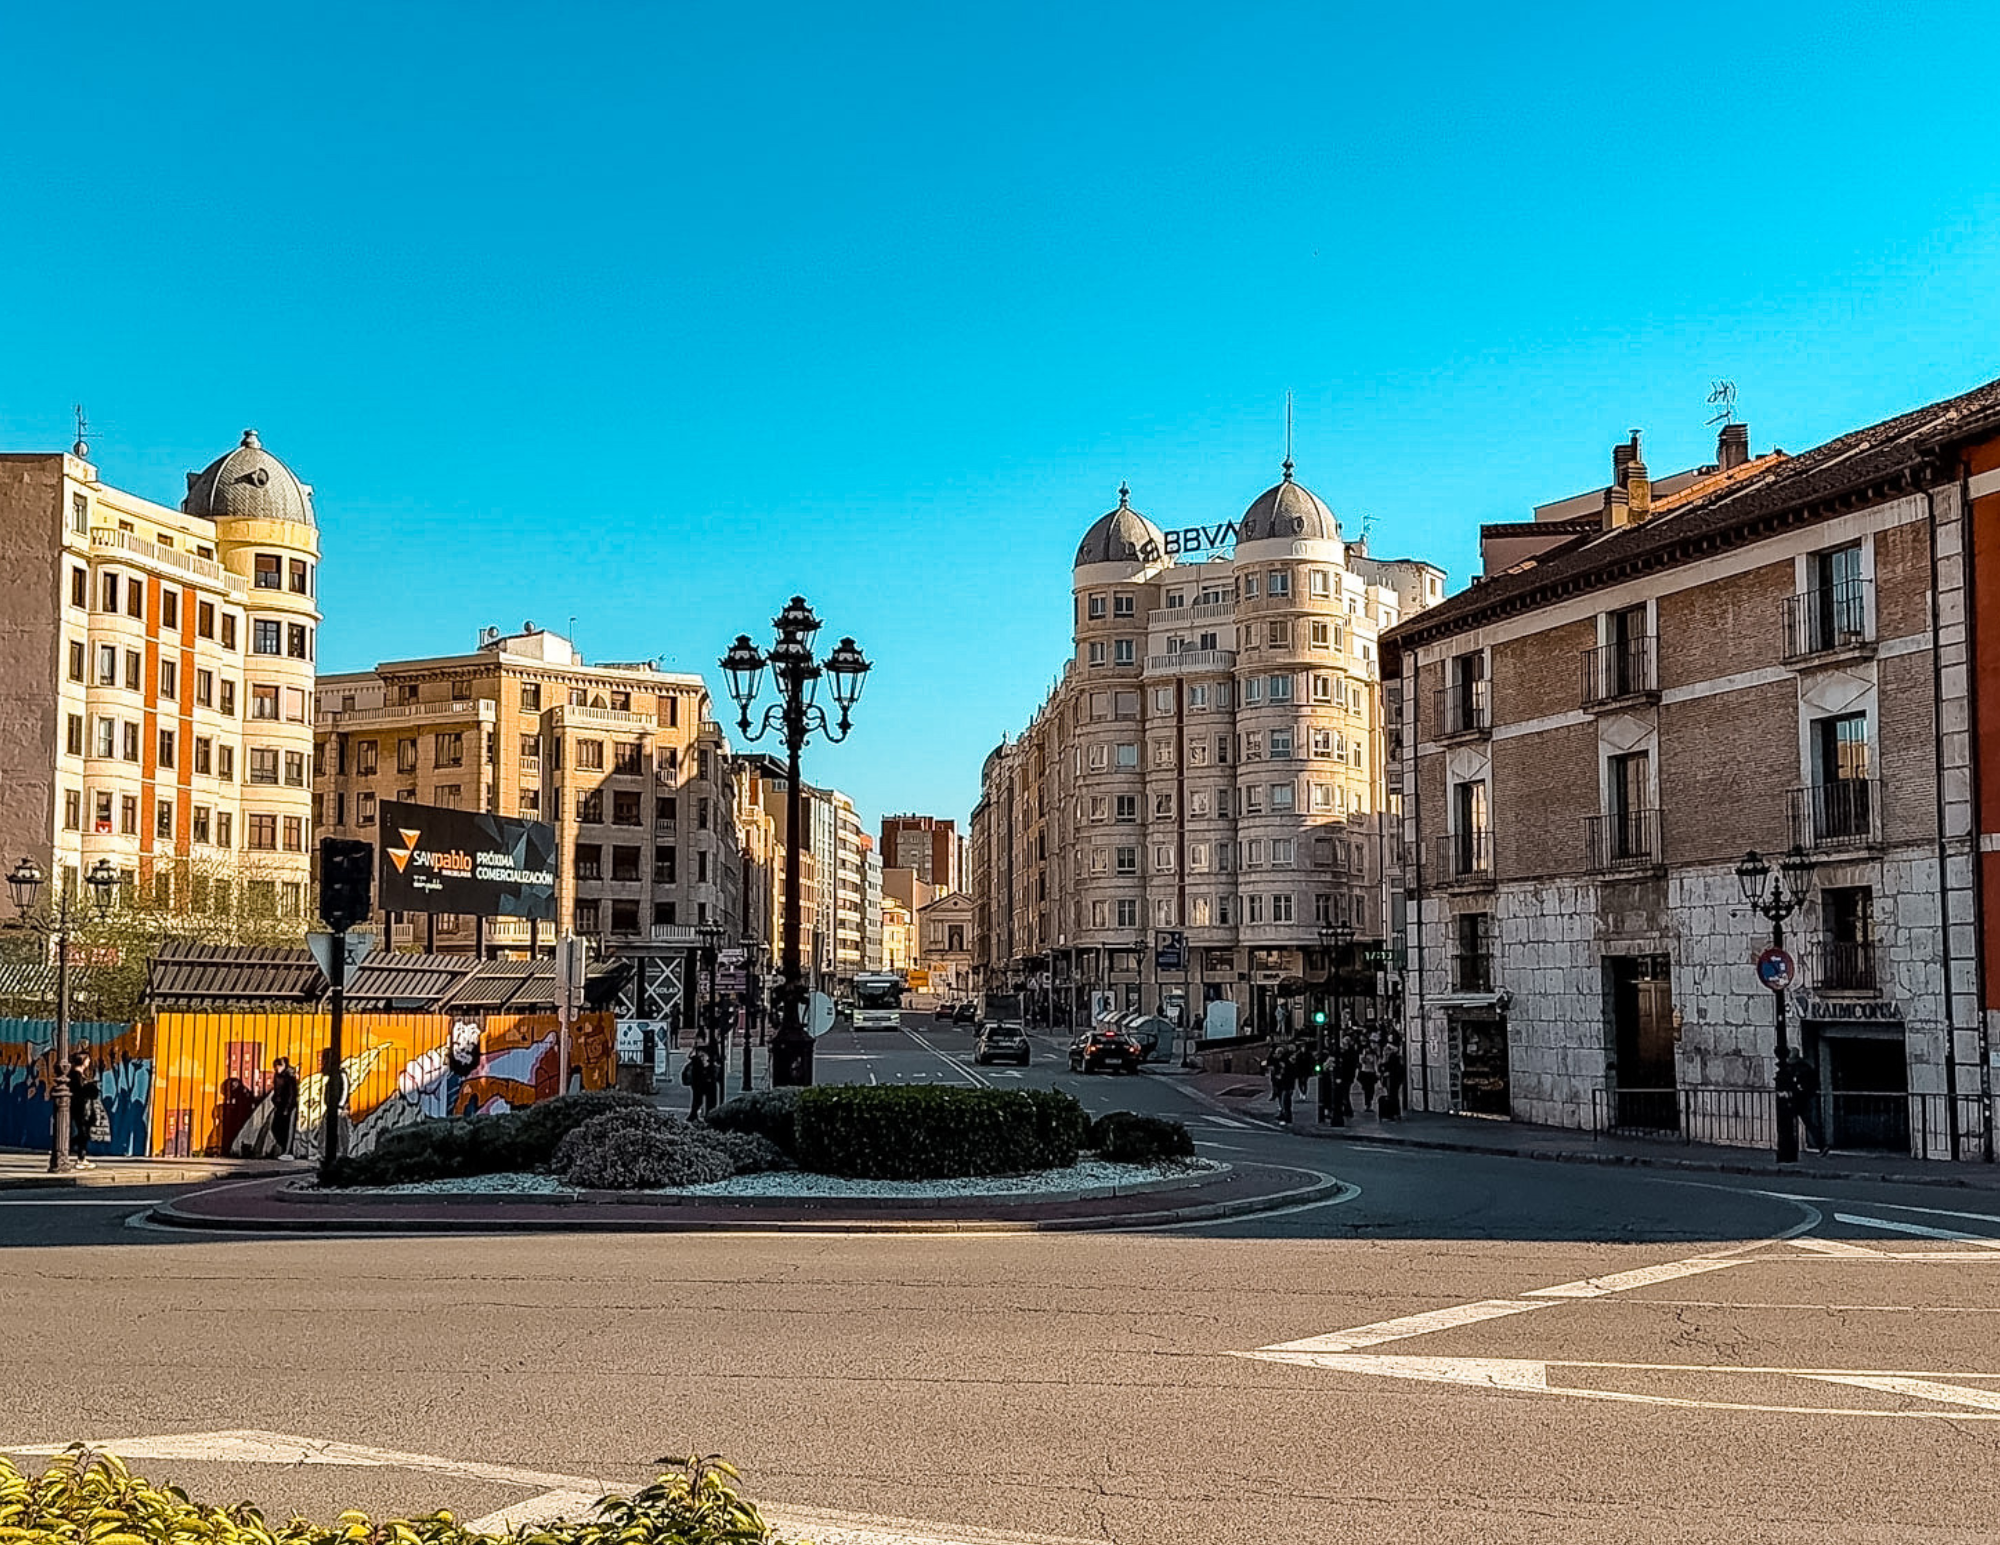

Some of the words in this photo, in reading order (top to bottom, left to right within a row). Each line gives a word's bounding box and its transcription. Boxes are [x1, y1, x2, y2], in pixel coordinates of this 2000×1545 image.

[1164, 519, 1239, 554] BBVA
[476, 850, 515, 867] PRÓXIMA
[476, 867, 554, 885] COMERCIALIZACIÓN
[1157, 933, 1172, 951] P
